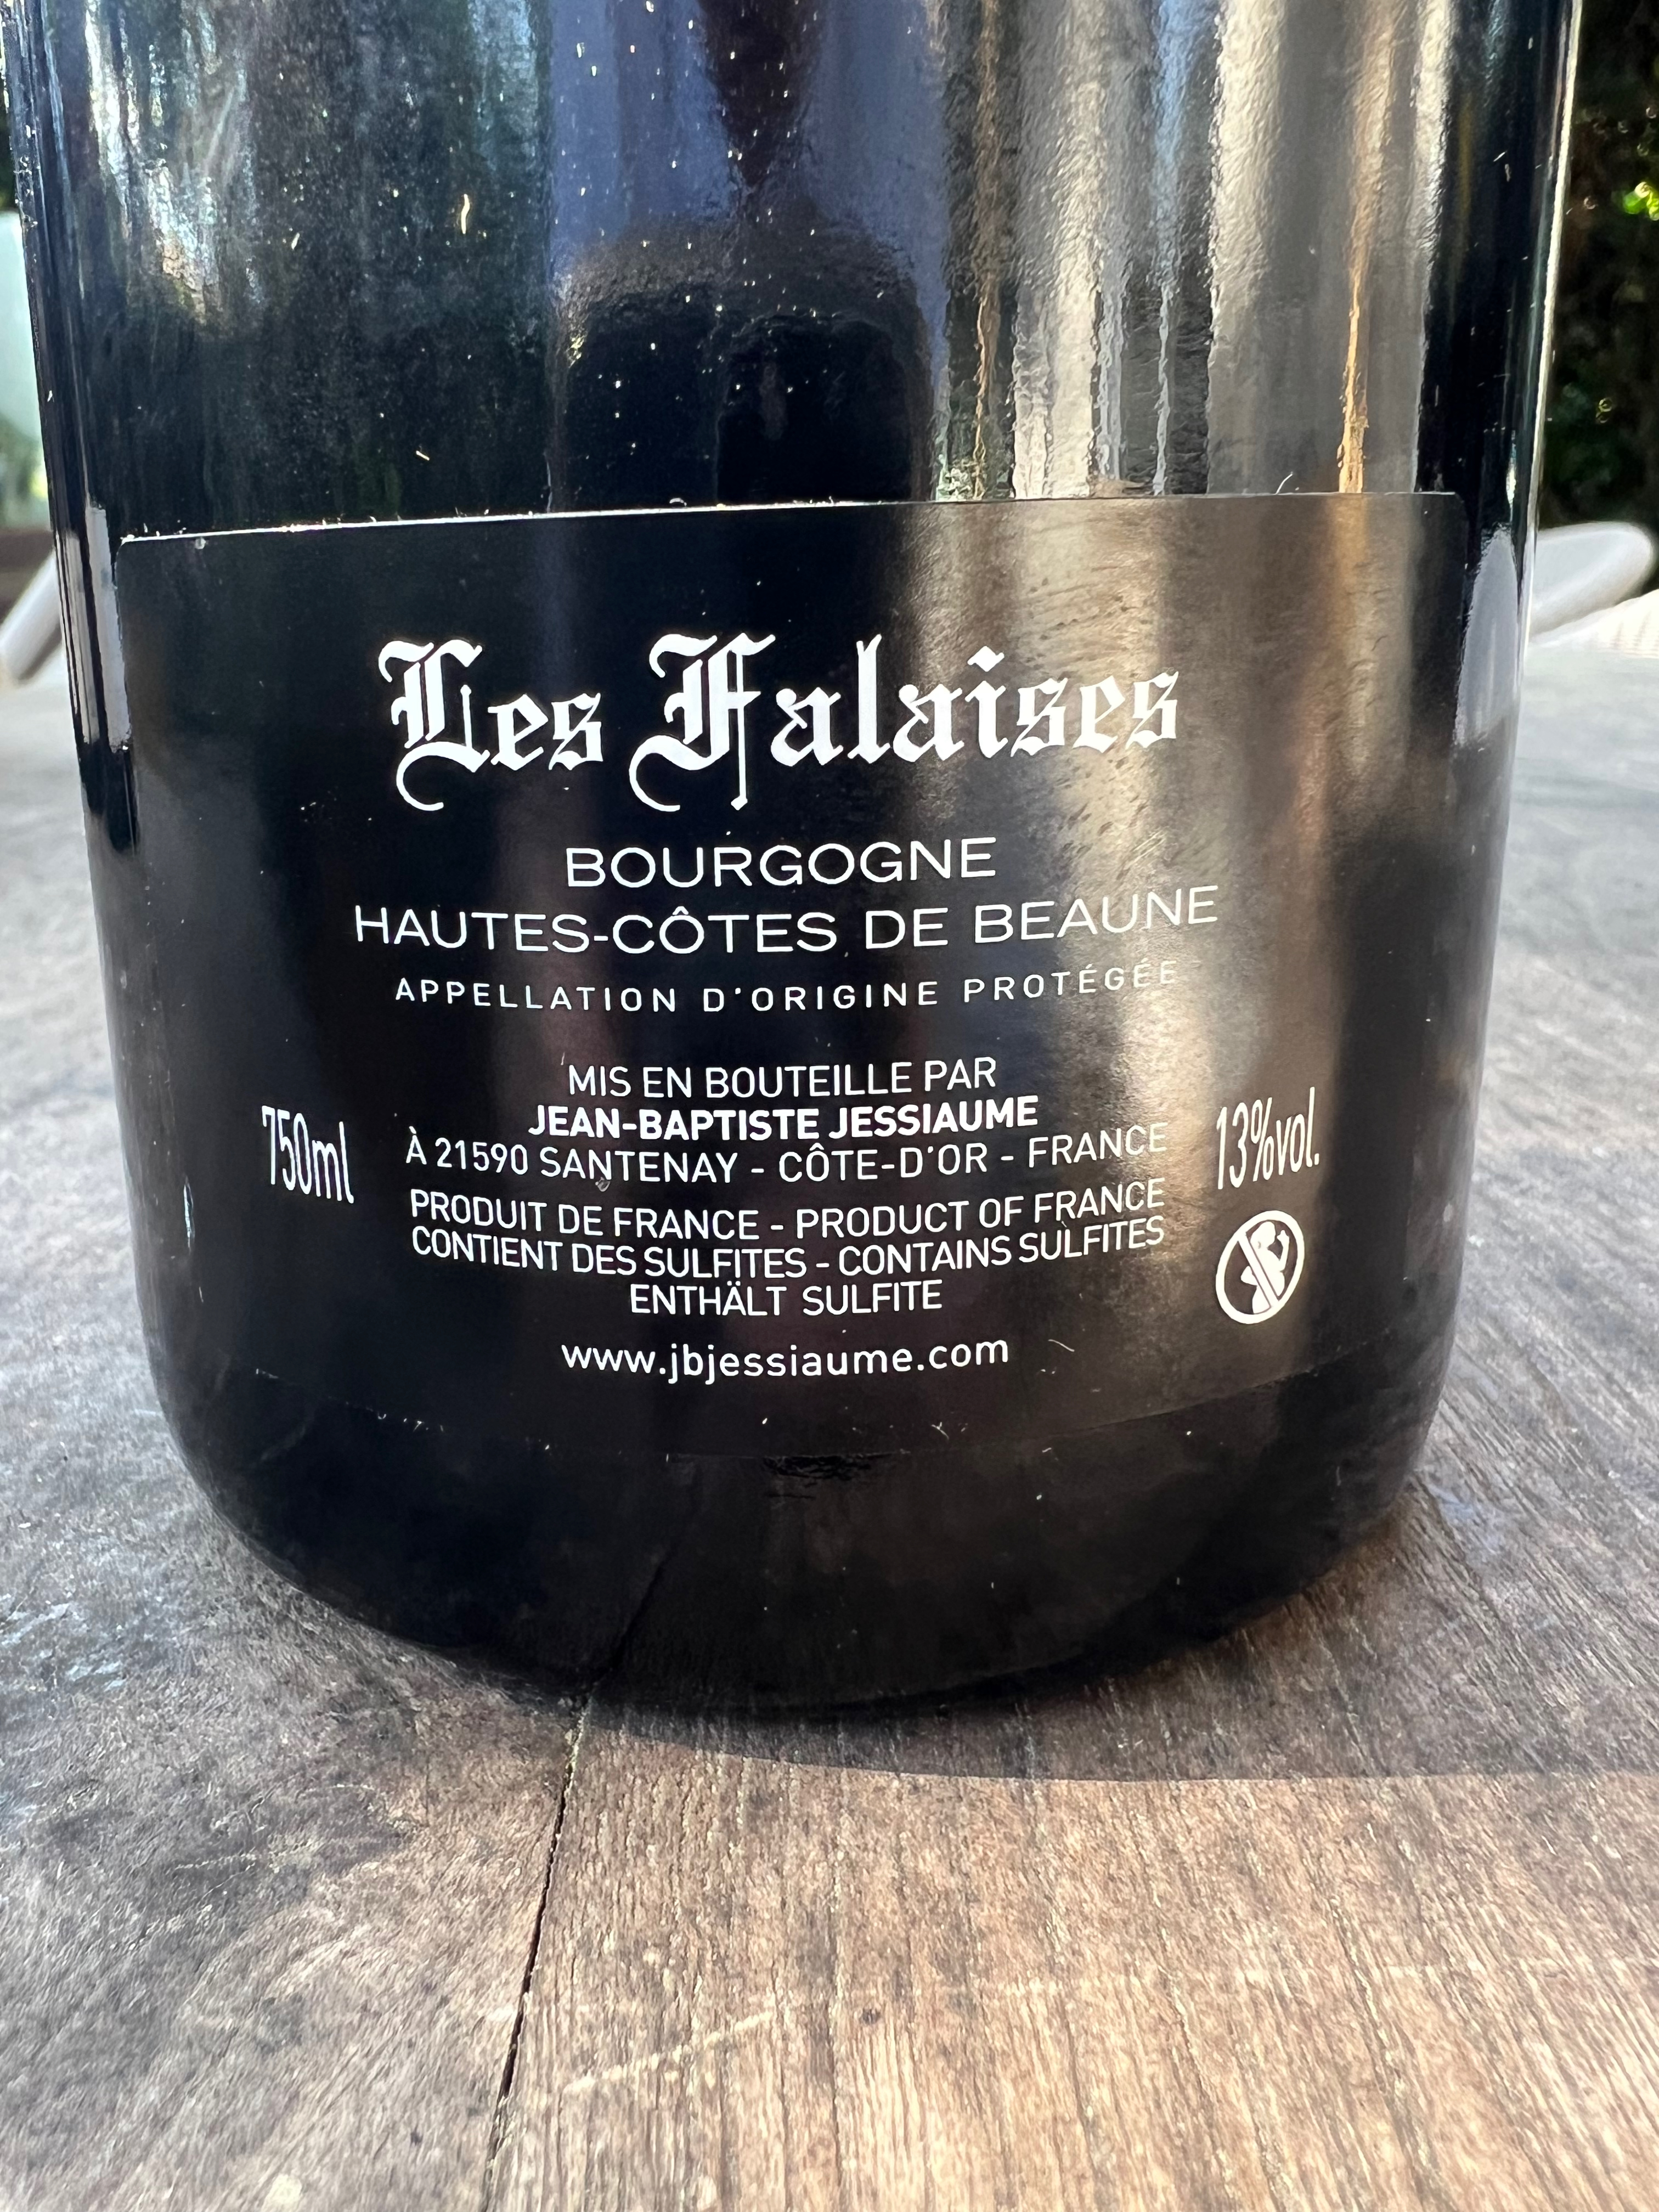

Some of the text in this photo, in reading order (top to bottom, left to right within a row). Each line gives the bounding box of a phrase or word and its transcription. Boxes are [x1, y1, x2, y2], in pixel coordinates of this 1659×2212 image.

[379, 633, 1179, 811] Les Falaises
[566, 837, 996, 889] BOURGOGNE
[355, 885, 1218, 953] HAUTES-CÔTES DE BEAUNE
[395, 960, 1177, 1012] APPELLATION D'ORIGINE PROTÉGÉE
[568, 1057, 997, 1098] MIS EN BOUTEILLE PAR
[528, 1095, 1039, 1141] JEAN-BAPTISTE JESSIAUME
[1215, 1087, 1319, 1190] 13%vol.
[262, 1105, 354, 1204] 750ml
[405, 1126, 427, 1165] À
[436, 1137, 529, 1175] 21590
[540, 1147, 738, 1183] SANTENAY
[778, 1142, 988, 1183] CÔTE-D'OR
[1028, 1122, 1168, 1169] FRANCE
[411, 1188, 548, 1231] PRODUIT
[558, 1204, 603, 1235] DE
[614, 1207, 760, 1241] FRANCE
[796, 1200, 969, 1239] PRODUCT
[978, 1195, 1024, 1228] OF
[1035, 1177, 1165, 1223] FRANCE
[412, 1226, 562, 1271] CONTIENT
[572, 1244, 636, 1274] DES
[645, 1246, 806, 1278] SULFITES
[838, 1234, 1012, 1276] CONTAINS
[1019, 1216, 1165, 1262] SULFITES
[630, 1279, 943, 1316] ENTHÄLT SULFITE
[562, 1339, 1008, 1385] www.jbjessiaume.com
